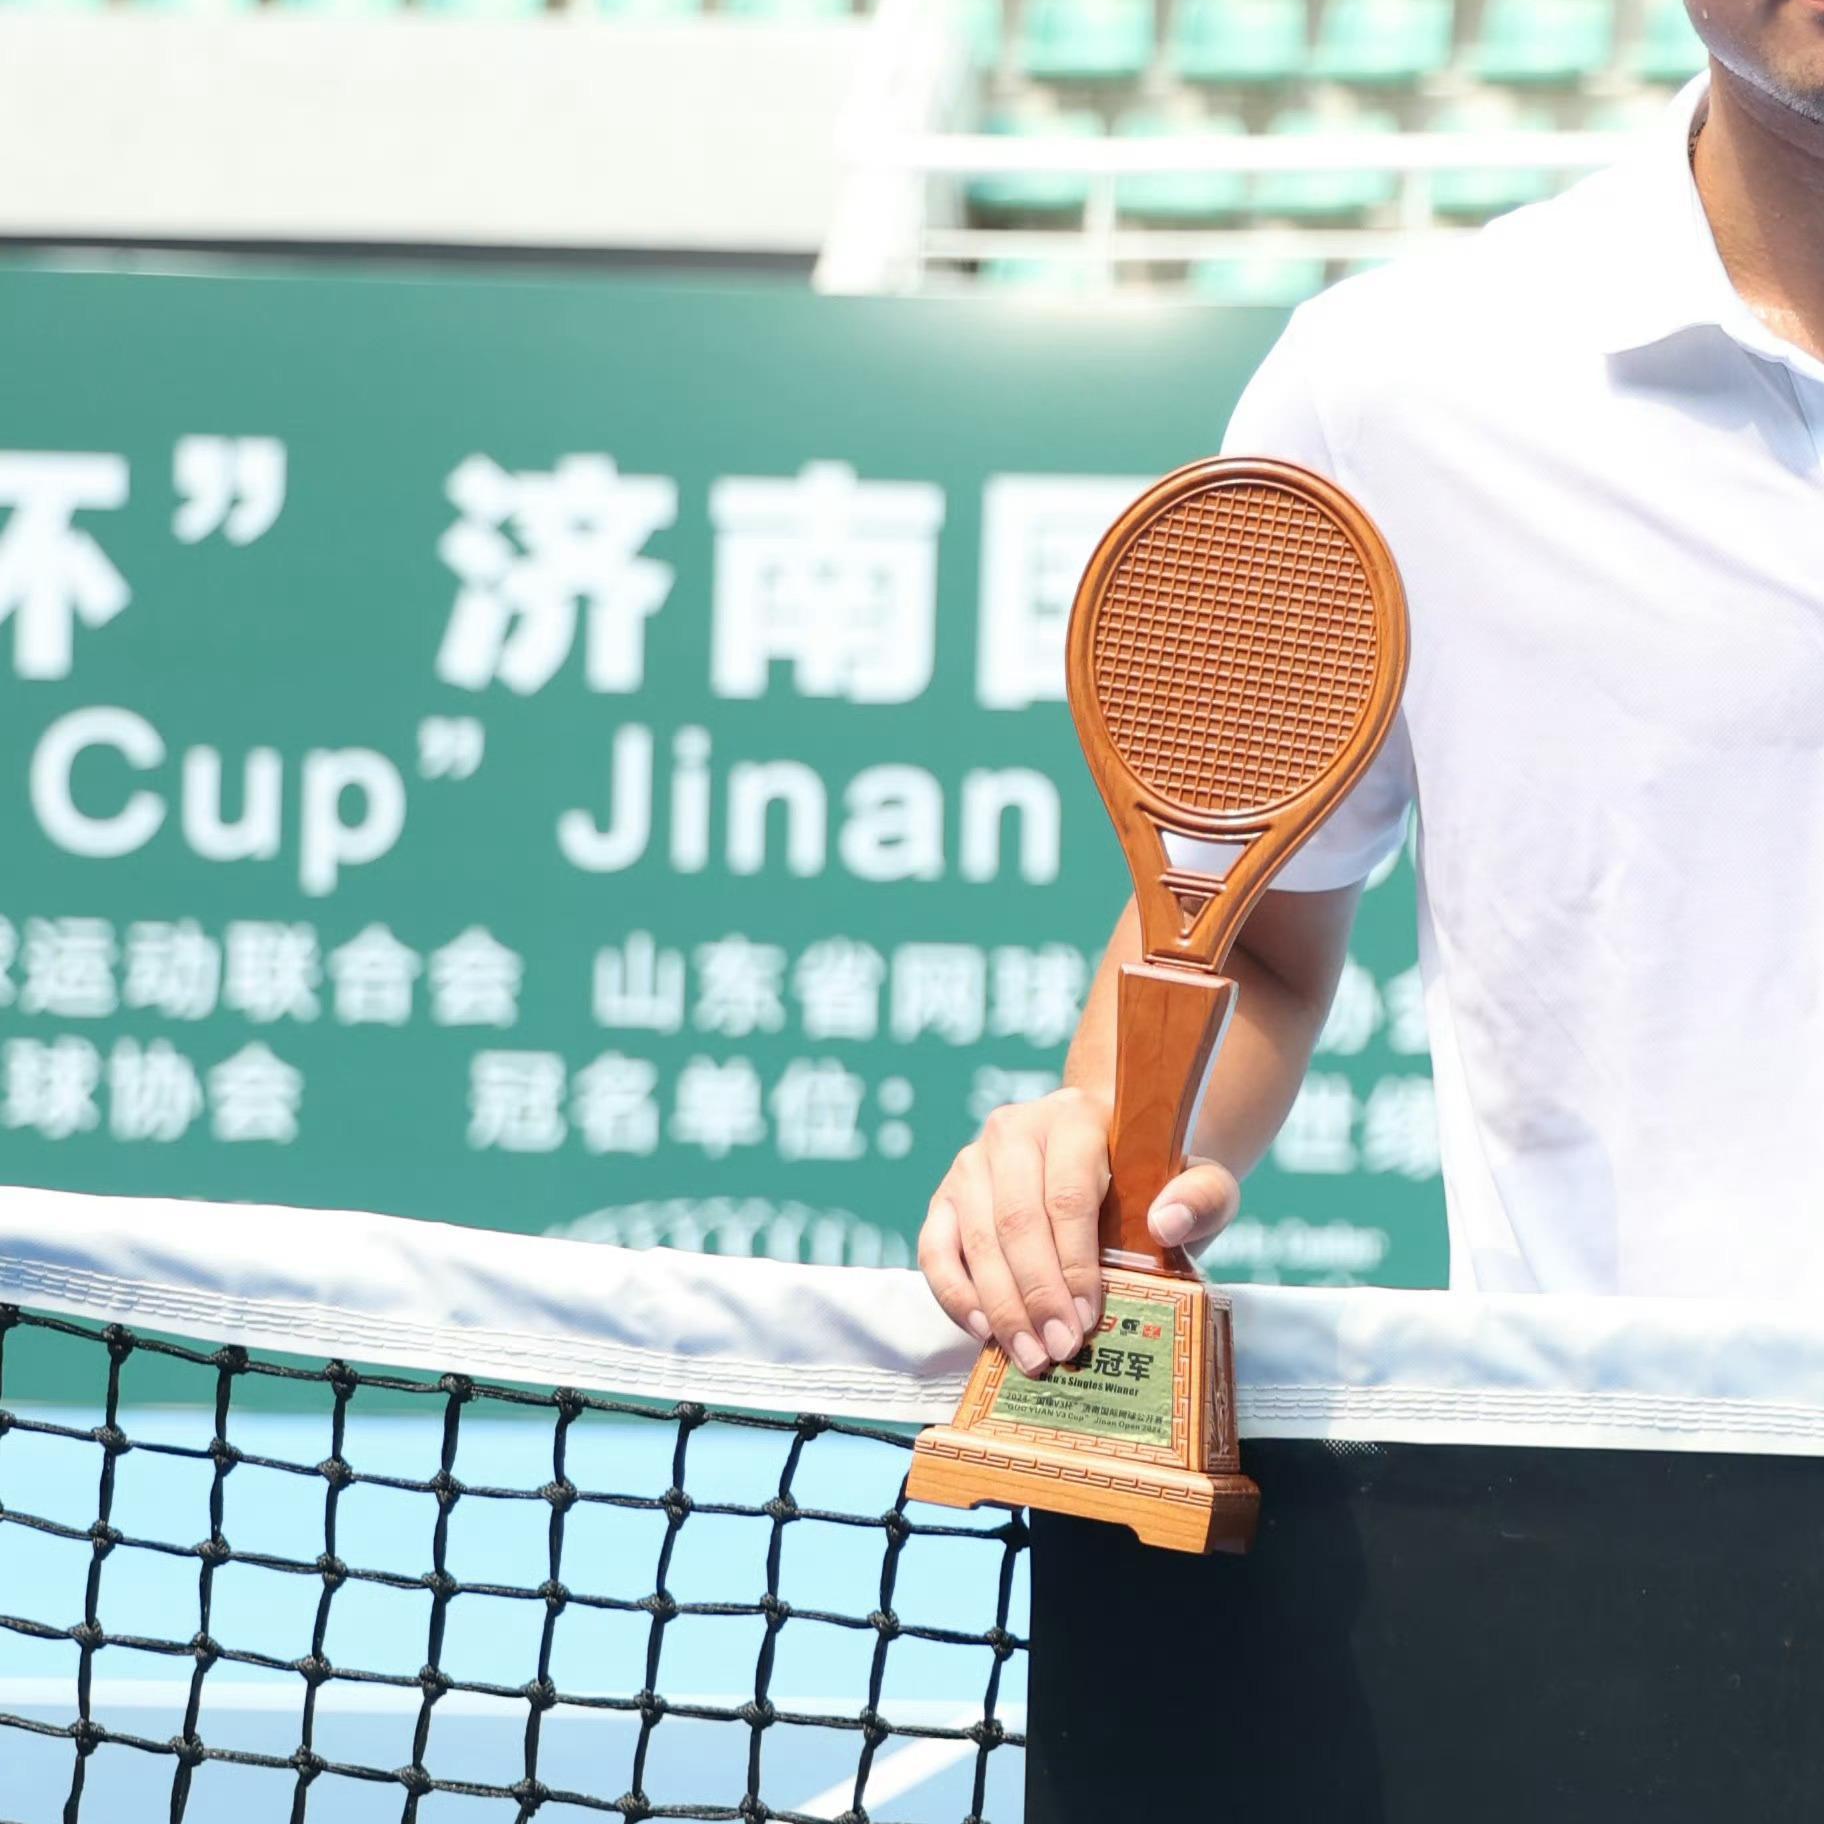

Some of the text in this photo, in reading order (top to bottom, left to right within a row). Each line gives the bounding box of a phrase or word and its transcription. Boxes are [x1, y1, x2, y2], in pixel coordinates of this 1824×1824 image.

[557, 726, 1062, 886] Jinan
[0, 916, 1100, 1048] 运动联合会 山东省网球
[1068, 1376, 1103, 1392] Singles
[1104, 1382, 1139, 1397] Winner
